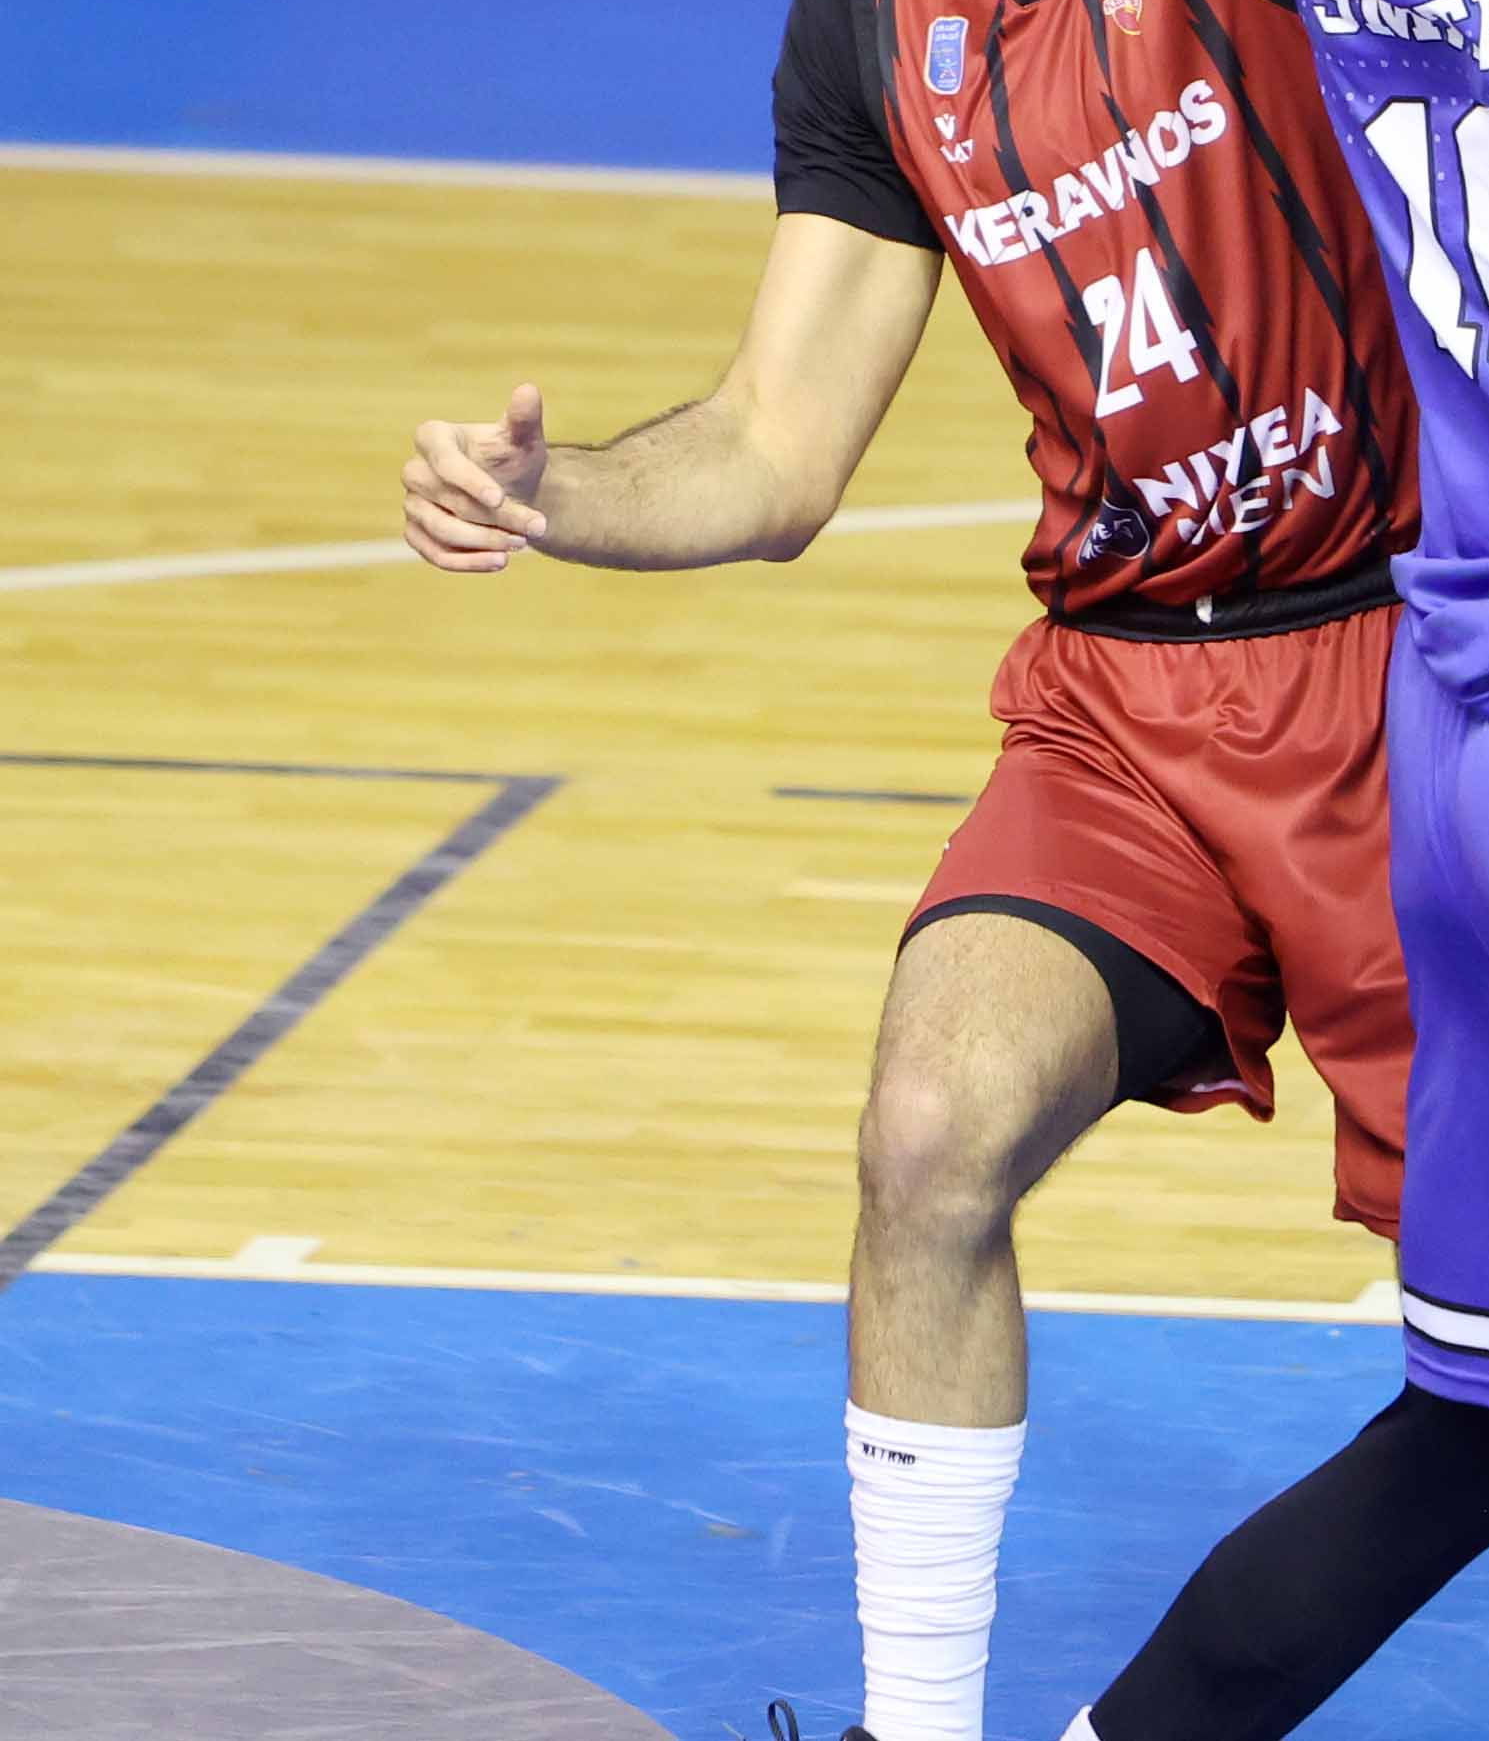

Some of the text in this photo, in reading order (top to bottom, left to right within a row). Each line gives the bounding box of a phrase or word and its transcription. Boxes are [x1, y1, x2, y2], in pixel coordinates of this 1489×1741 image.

[944, 79, 1226, 267] KERAVNOS
[1081, 248, 1197, 418] 24
[1131, 386, 1343, 517] NIVEA
